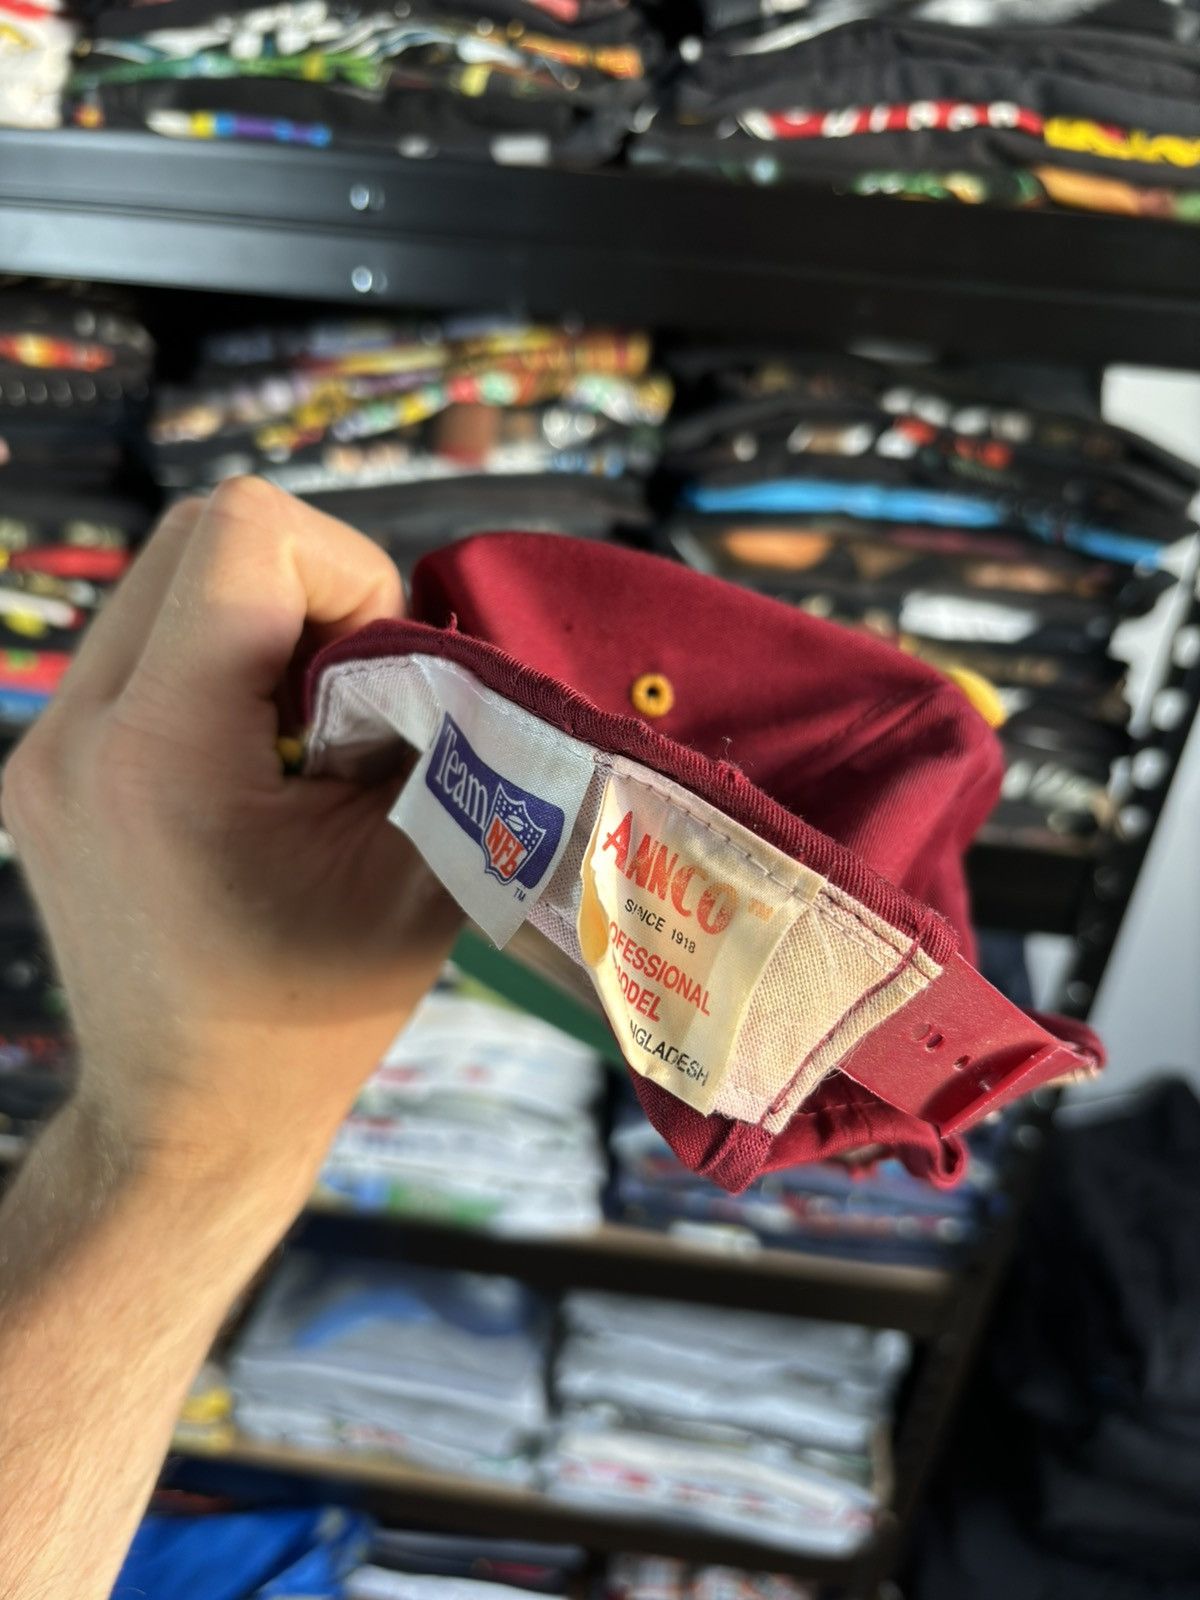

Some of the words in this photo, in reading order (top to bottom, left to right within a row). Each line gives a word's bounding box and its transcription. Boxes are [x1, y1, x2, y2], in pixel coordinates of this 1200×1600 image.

[435, 725, 490, 830] Team
[485, 816, 526, 878] NFL
[602, 811, 738, 936] ANNCO
[624, 898, 666, 933] SINCE
[671, 928, 697, 954] 1918
[609, 921, 710, 1017] OFESSIONAL
[616, 964, 661, 1022] ODEL
[630, 1019, 710, 1087] NGLADESH
